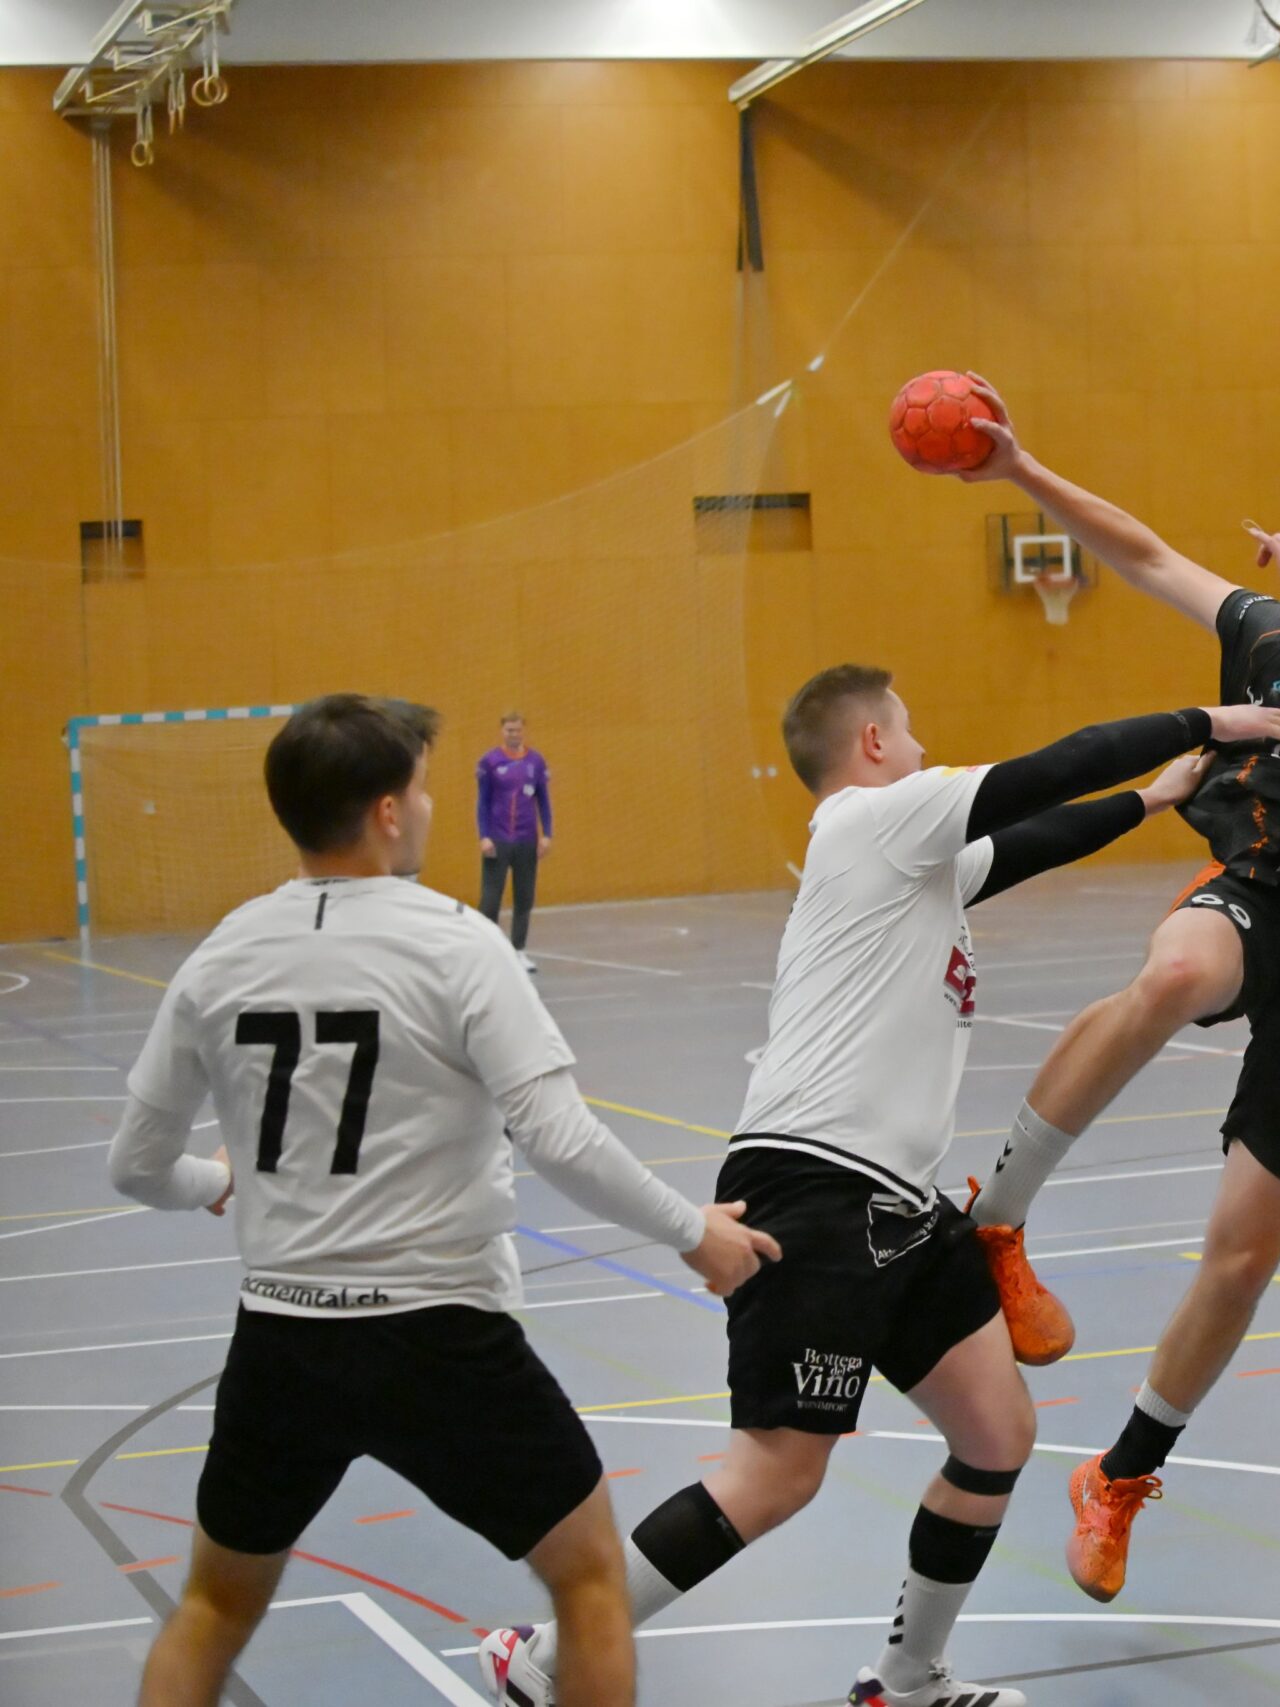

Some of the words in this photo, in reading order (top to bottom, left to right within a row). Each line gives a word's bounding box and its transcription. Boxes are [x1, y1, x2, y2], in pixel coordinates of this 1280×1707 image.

[235, 1010, 380, 1175] 77
[804, 1347, 863, 1373] Bottega
[791, 1361, 861, 1399] Vino
